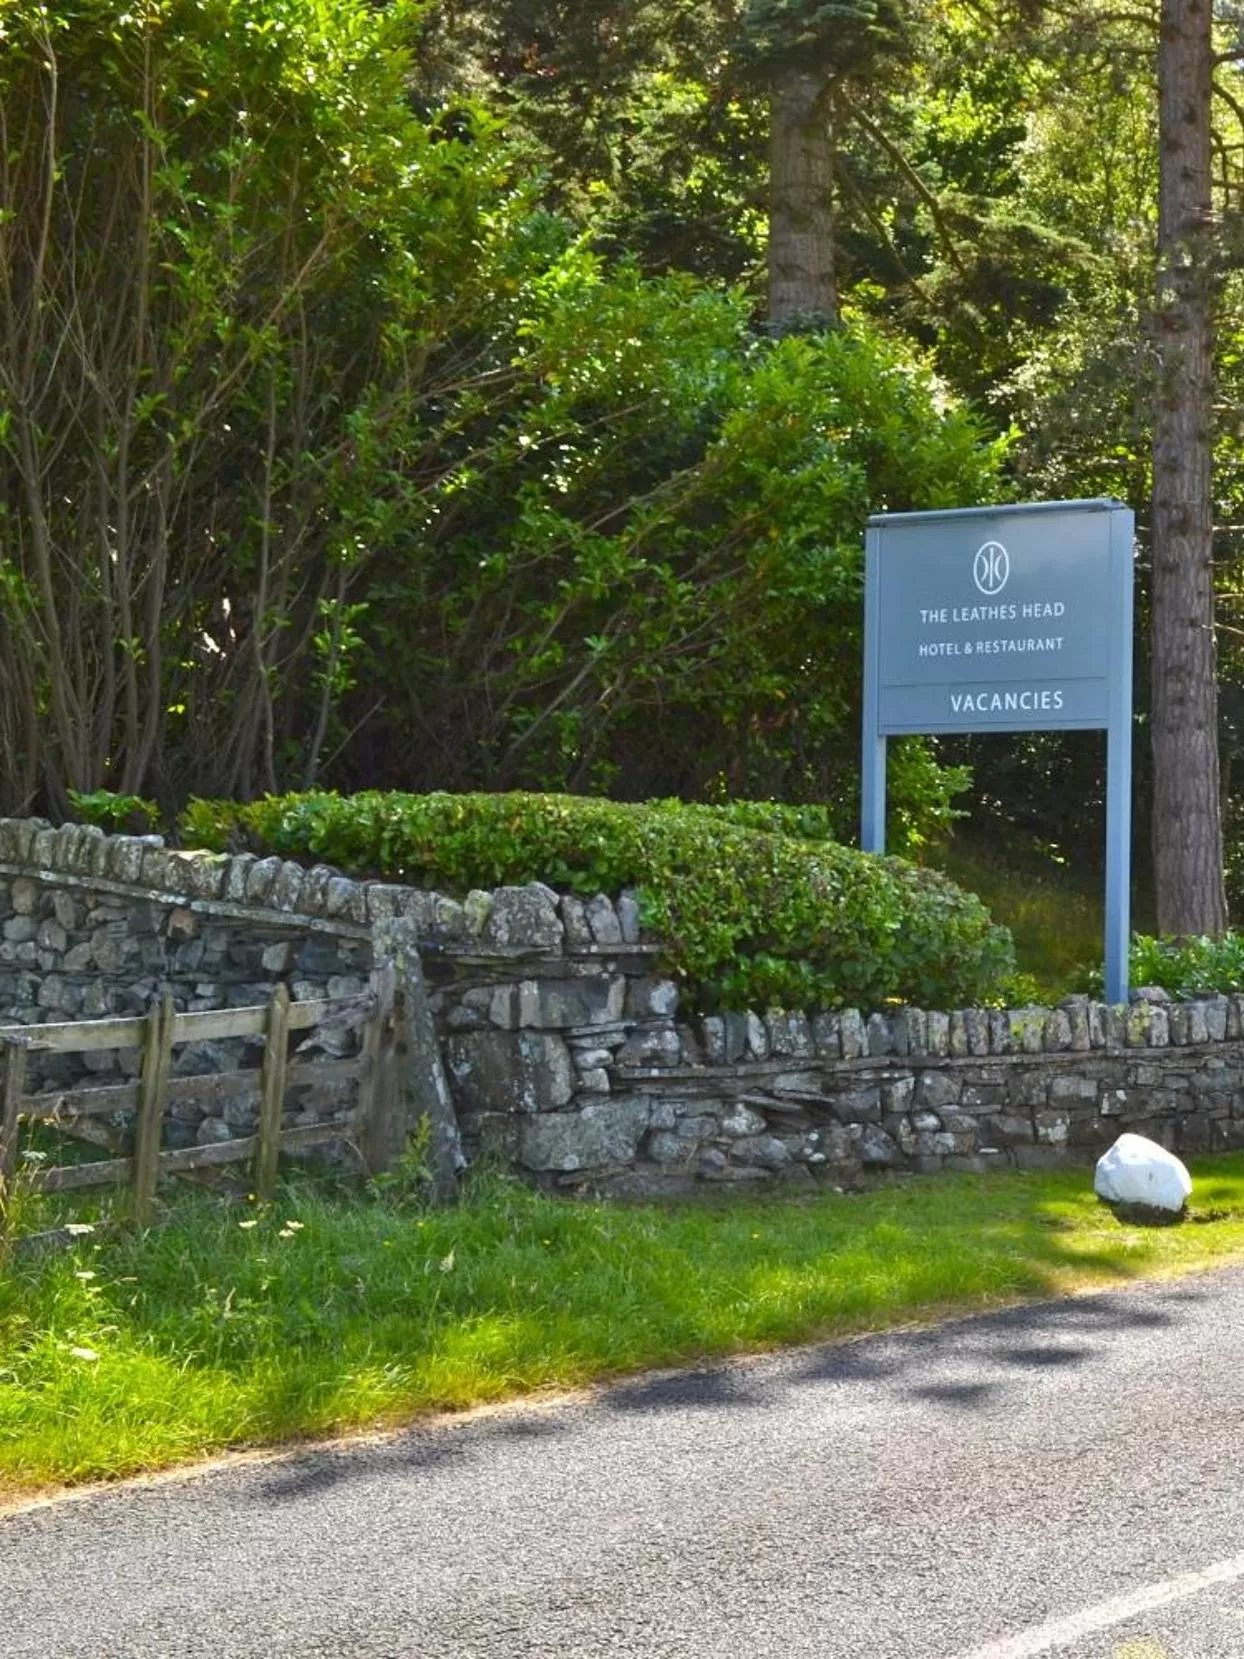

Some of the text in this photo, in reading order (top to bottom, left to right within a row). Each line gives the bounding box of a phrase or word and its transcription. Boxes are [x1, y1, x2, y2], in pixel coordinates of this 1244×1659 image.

[919, 602, 1065, 624] THE LEATHES HEAD
[919, 637, 1064, 656] HOTEL & RESTAURANT
[951, 691, 1064, 712] VACANCIES
